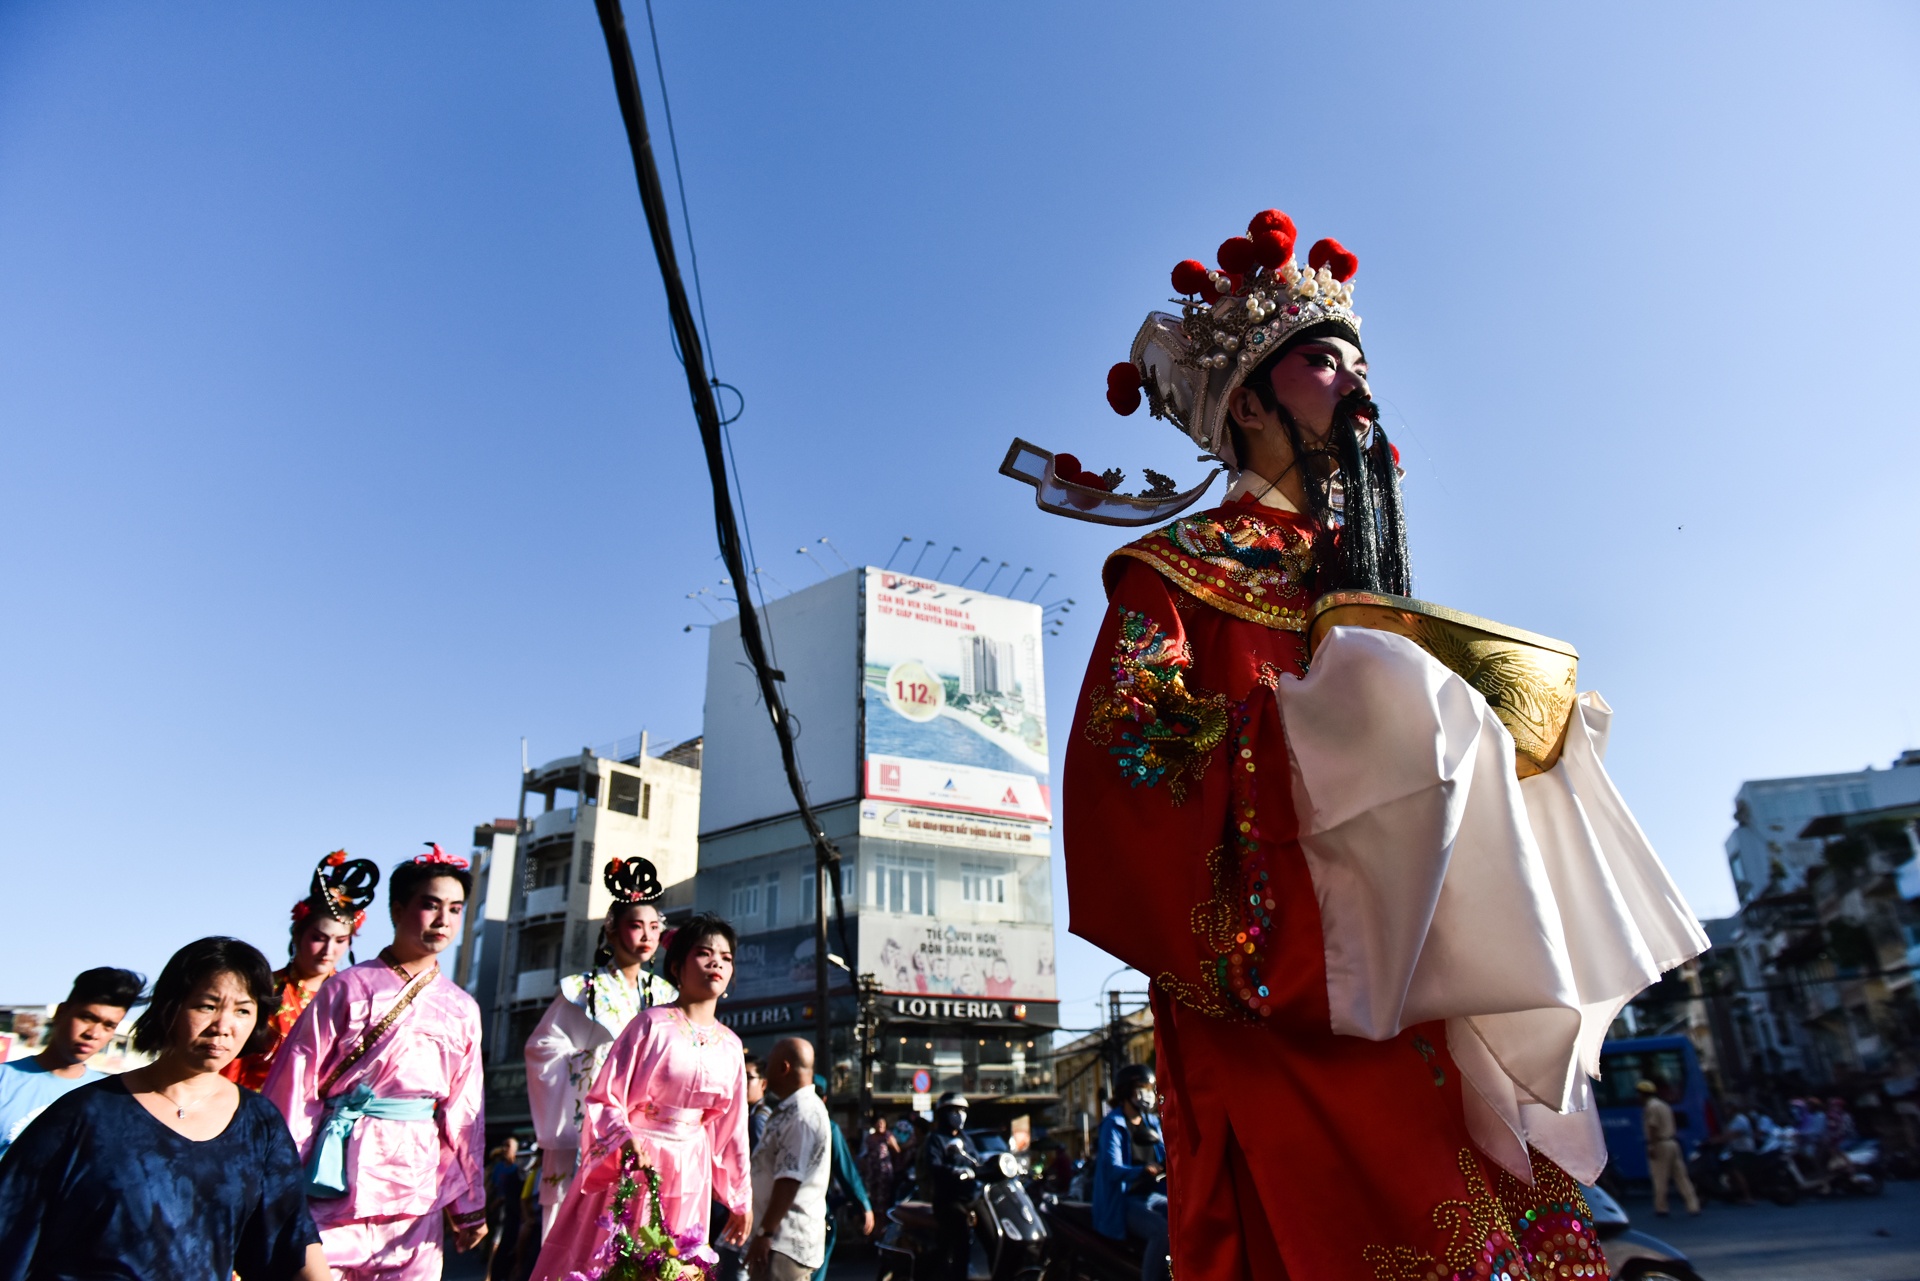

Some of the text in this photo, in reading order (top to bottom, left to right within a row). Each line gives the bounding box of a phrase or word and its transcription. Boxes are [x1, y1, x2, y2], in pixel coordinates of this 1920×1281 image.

[895, 680, 928, 704] 1,12
[720, 1006, 791, 1028] OTTERIA
[898, 999, 1003, 1018] LOTTERIA
